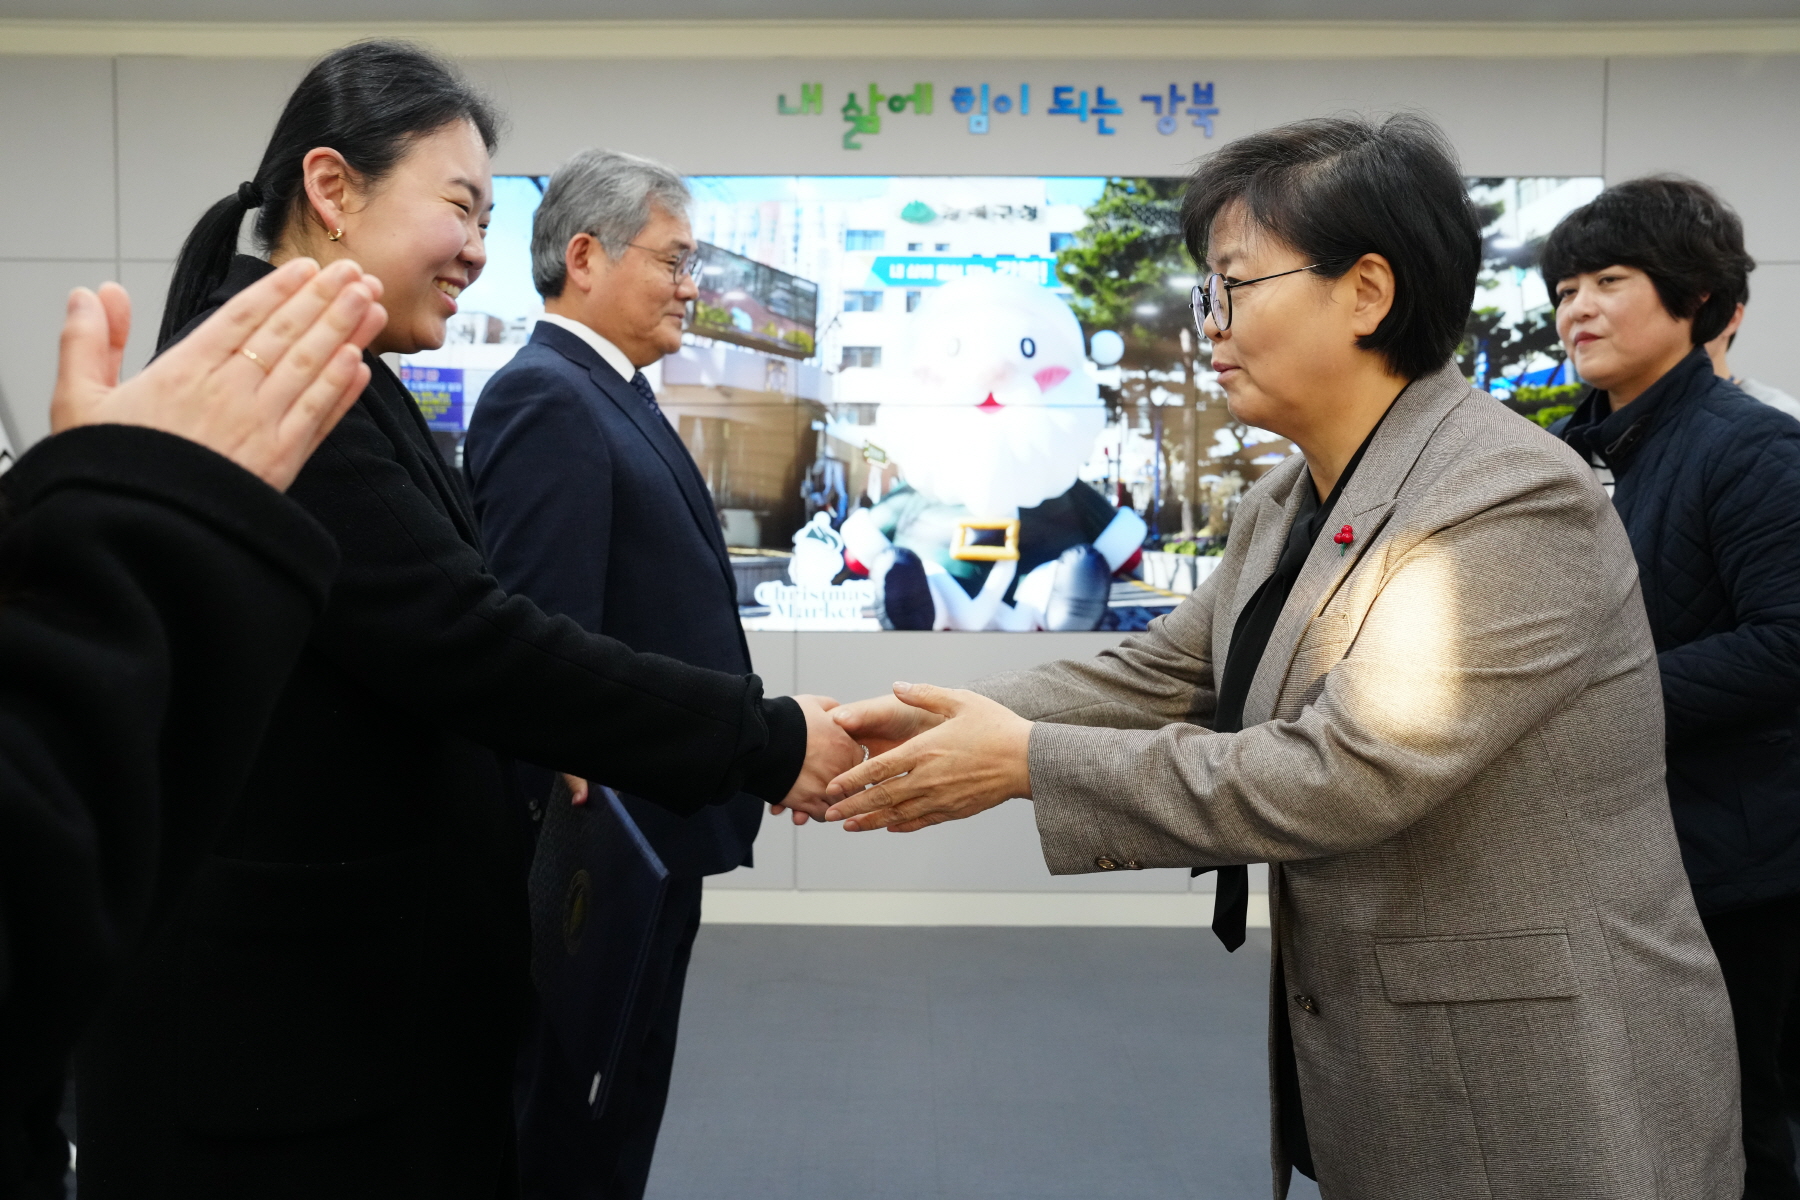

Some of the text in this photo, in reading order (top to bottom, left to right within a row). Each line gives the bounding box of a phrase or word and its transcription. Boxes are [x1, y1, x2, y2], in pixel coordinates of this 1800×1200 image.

[778, 83, 1219, 150] 내 삶에 힘이 되는 강북
[759, 586, 871, 600] Christmas
[776, 602, 857, 618] Market
